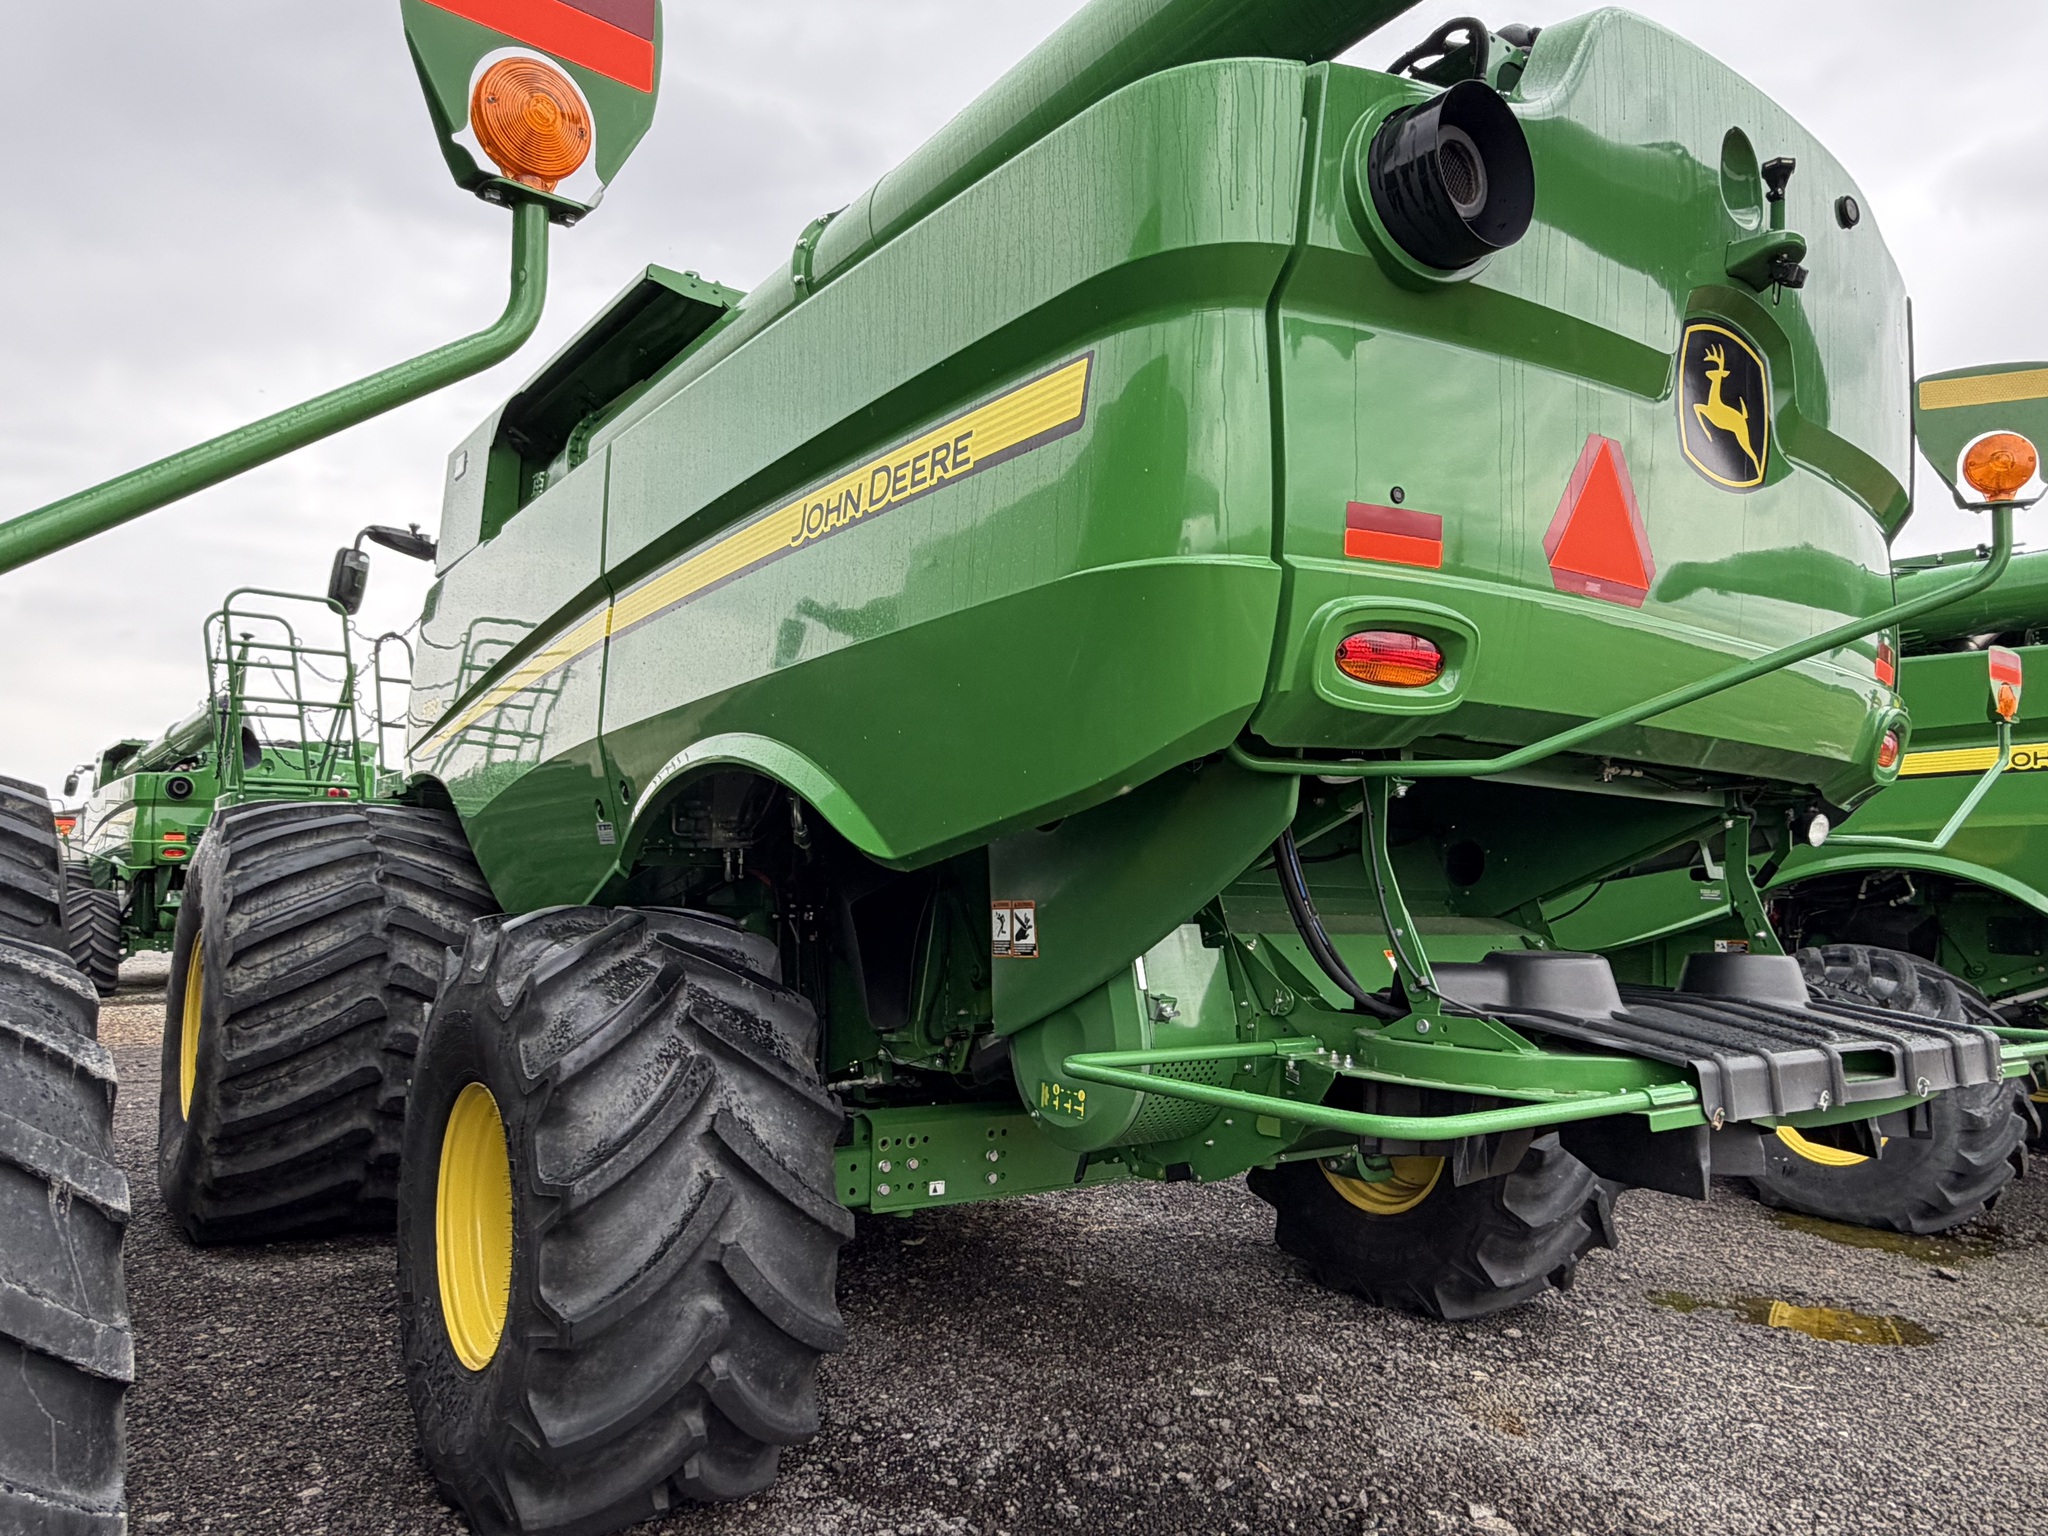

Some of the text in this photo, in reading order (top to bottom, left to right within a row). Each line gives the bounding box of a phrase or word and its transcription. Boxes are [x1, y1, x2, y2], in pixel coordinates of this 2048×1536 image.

[791, 429, 974, 543] JOHN DEERE
[2010, 751, 2048, 767] OH
